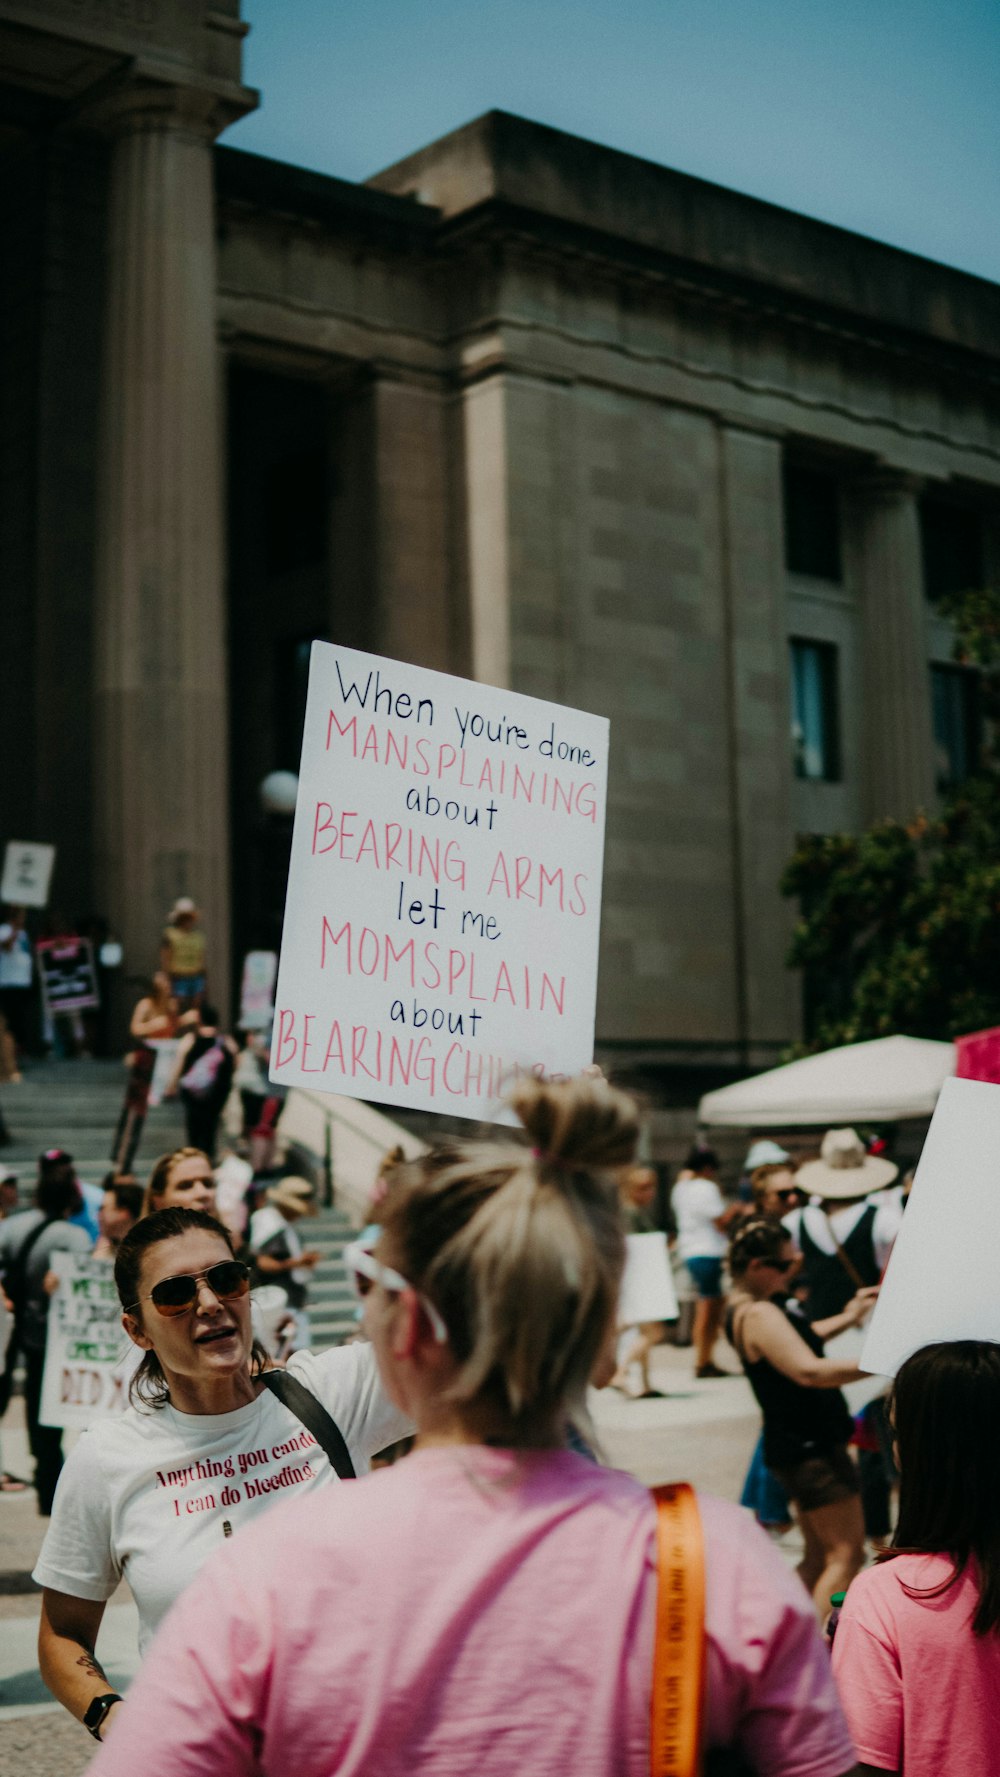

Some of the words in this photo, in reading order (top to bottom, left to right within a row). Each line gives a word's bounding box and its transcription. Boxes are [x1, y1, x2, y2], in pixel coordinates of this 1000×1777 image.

[335, 660, 433, 726] When
[455, 707, 529, 749] you're
[539, 722, 596, 767] done
[326, 709, 597, 823] MANSPLAINING
[406, 785, 498, 830] about
[312, 802, 465, 891] BEARING
[487, 850, 588, 915] ARMS
[398, 881, 446, 929] let
[462, 910, 501, 940] me
[321, 915, 565, 1015] MOMSPLAIN
[275, 1009, 435, 1097] BEARING
[443, 1042, 572, 1099] CHILR
[391, 998, 482, 1036] about
[155, 1454, 235, 1489] Anything
[237, 1448, 270, 1474] you
[271, 1438, 300, 1459] can
[173, 1499, 180, 1516] I
[186, 1493, 216, 1514] can
[220, 1485, 241, 1506] do
